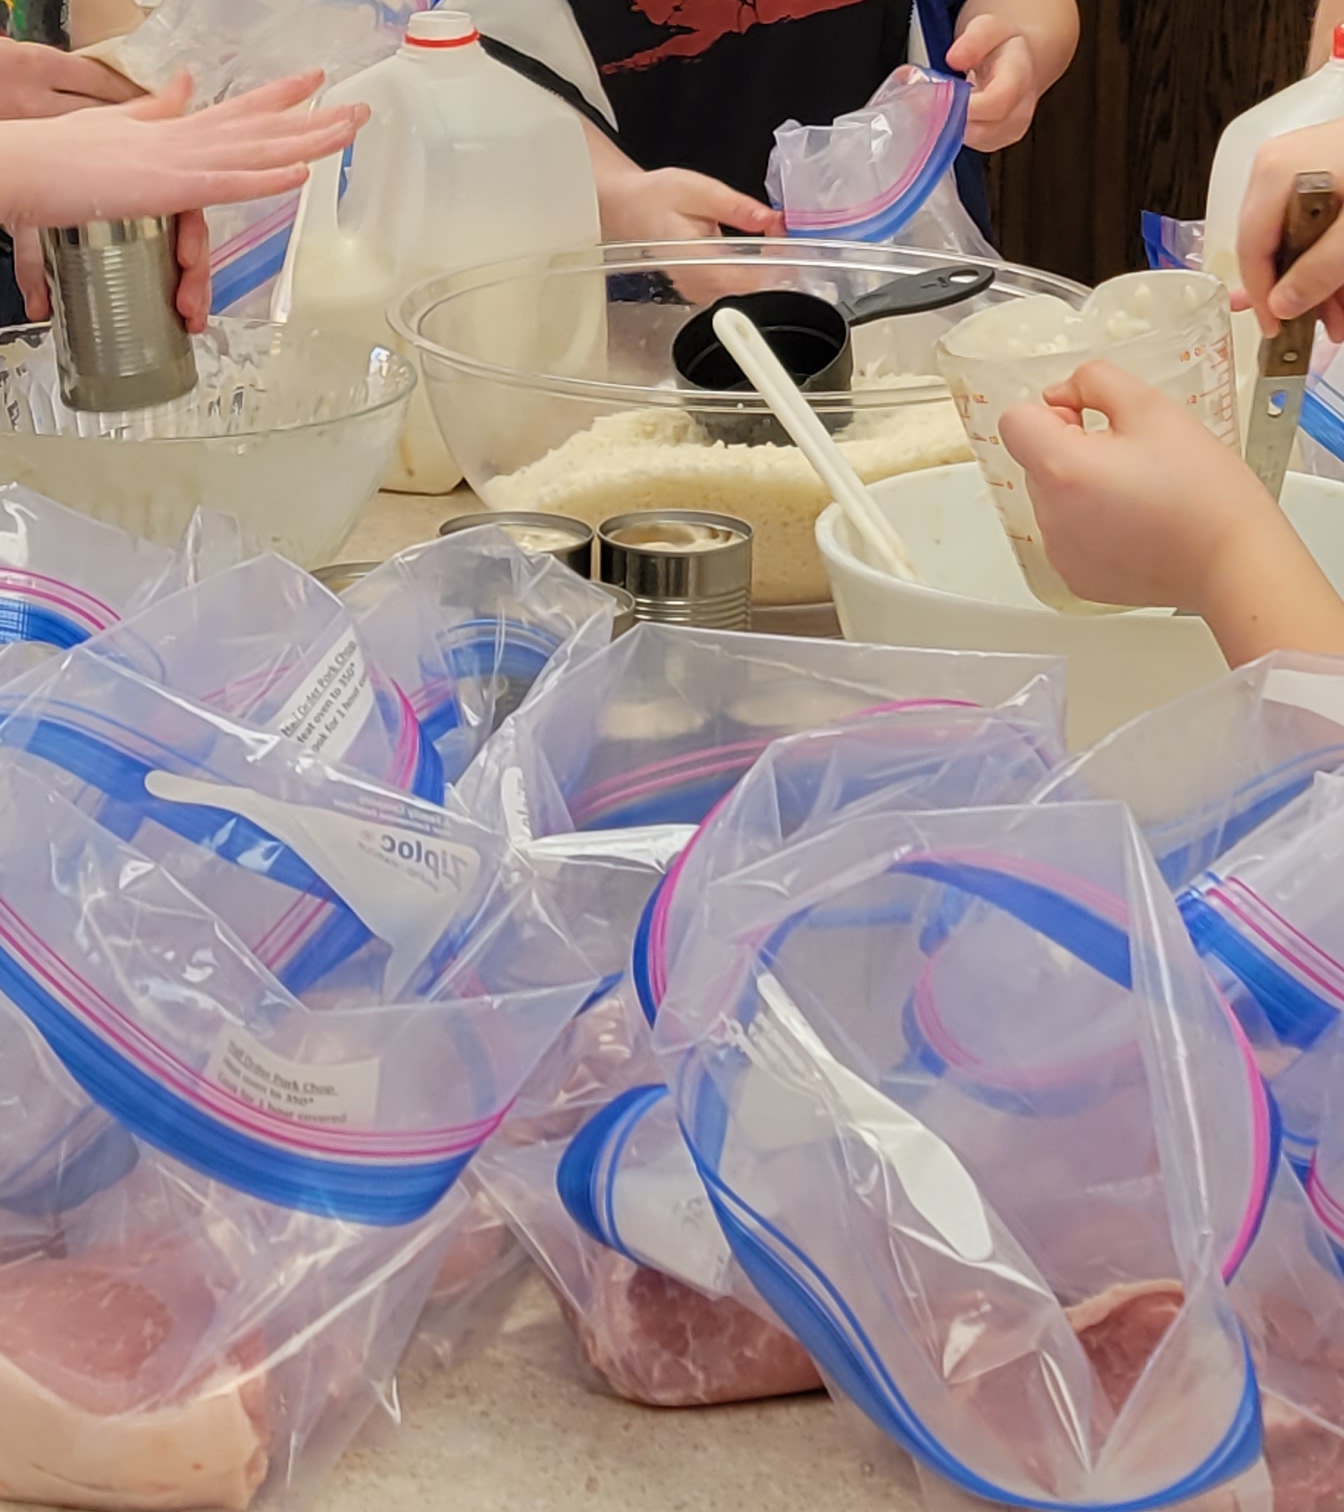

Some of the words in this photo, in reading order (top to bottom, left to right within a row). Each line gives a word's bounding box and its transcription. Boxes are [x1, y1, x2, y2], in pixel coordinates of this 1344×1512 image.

[317, 665, 340, 689] Pork
[311, 733, 329, 753] ook
[324, 717, 339, 735] for
[341, 687, 361, 712] hour
[313, 699, 334, 724] oven
[329, 688, 343, 700] to
